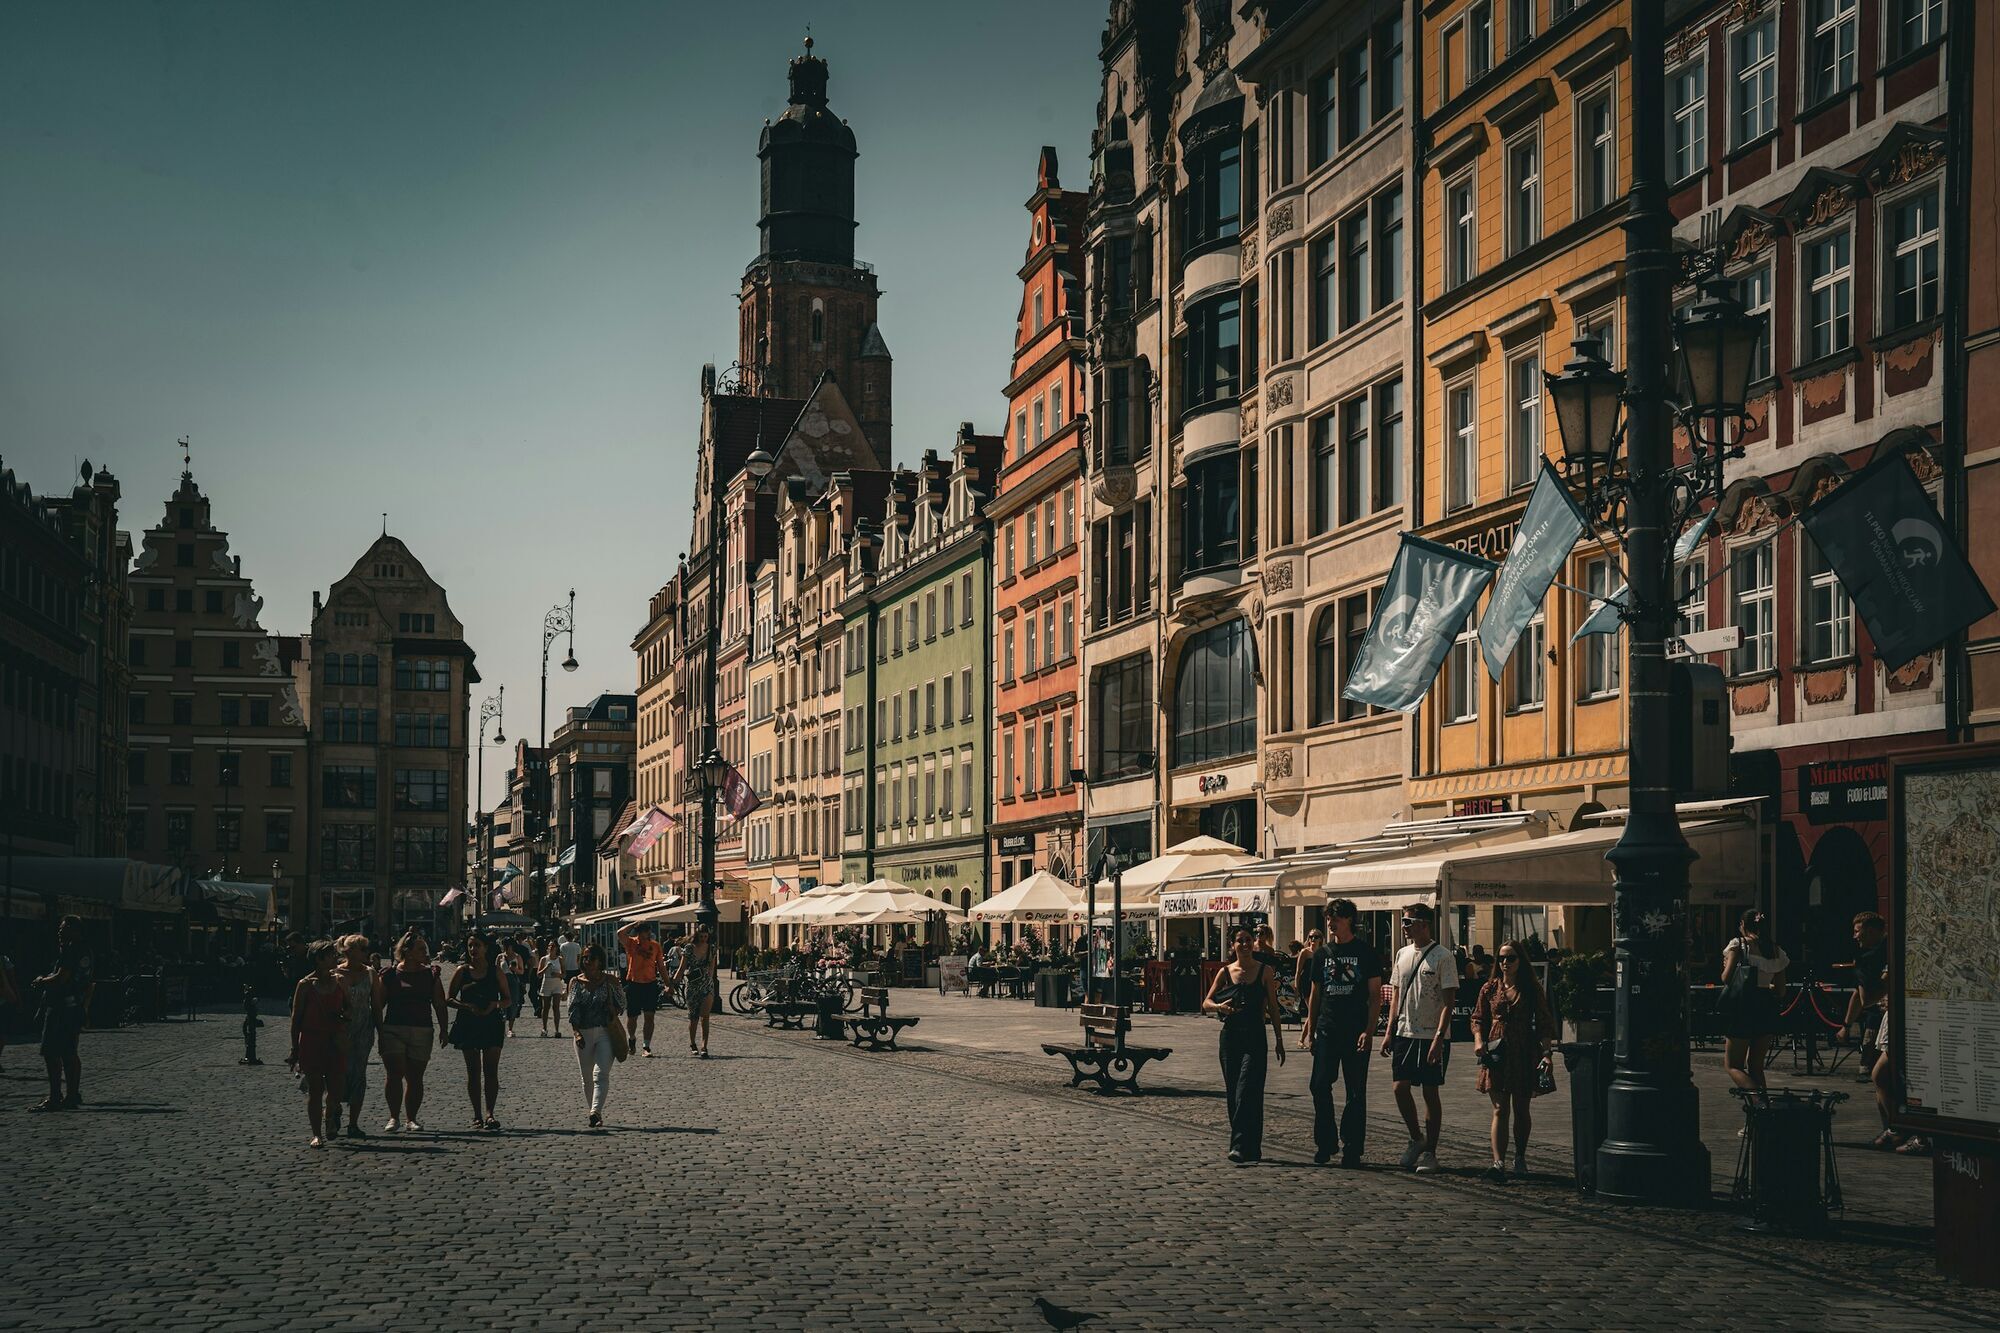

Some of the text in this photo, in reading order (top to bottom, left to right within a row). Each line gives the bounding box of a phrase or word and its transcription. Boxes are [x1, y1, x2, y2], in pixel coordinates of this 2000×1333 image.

[1465, 799, 1491, 816] HERT
[1034, 911, 1066, 921] Pizza Hut
[1128, 911, 1147, 919] Pizza
